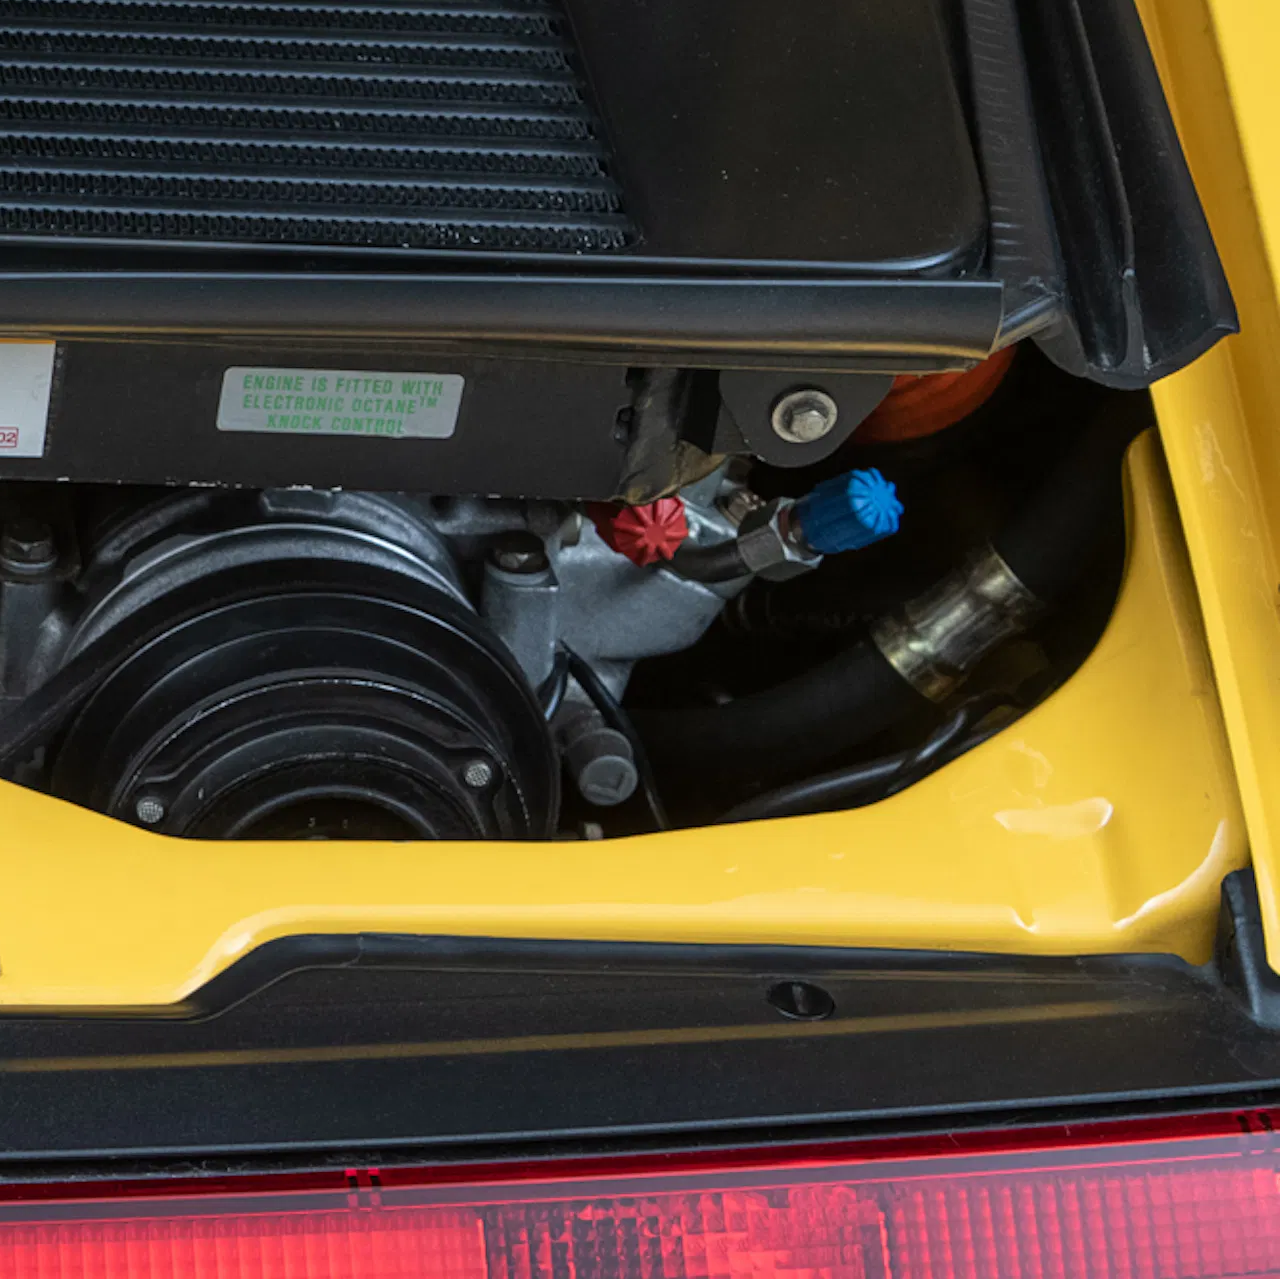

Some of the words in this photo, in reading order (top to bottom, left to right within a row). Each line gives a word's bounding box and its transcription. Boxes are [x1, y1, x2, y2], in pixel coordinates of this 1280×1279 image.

[242, 375, 305, 392] ENGINE
[310, 377, 328, 392] IS
[334, 378, 393, 395] FITTED
[401, 380, 444, 396] WITH
[242, 394, 344, 412] ELECTRONIC
[267, 414, 324, 431] KNOCK
[329, 416, 404, 434] CONTROL
